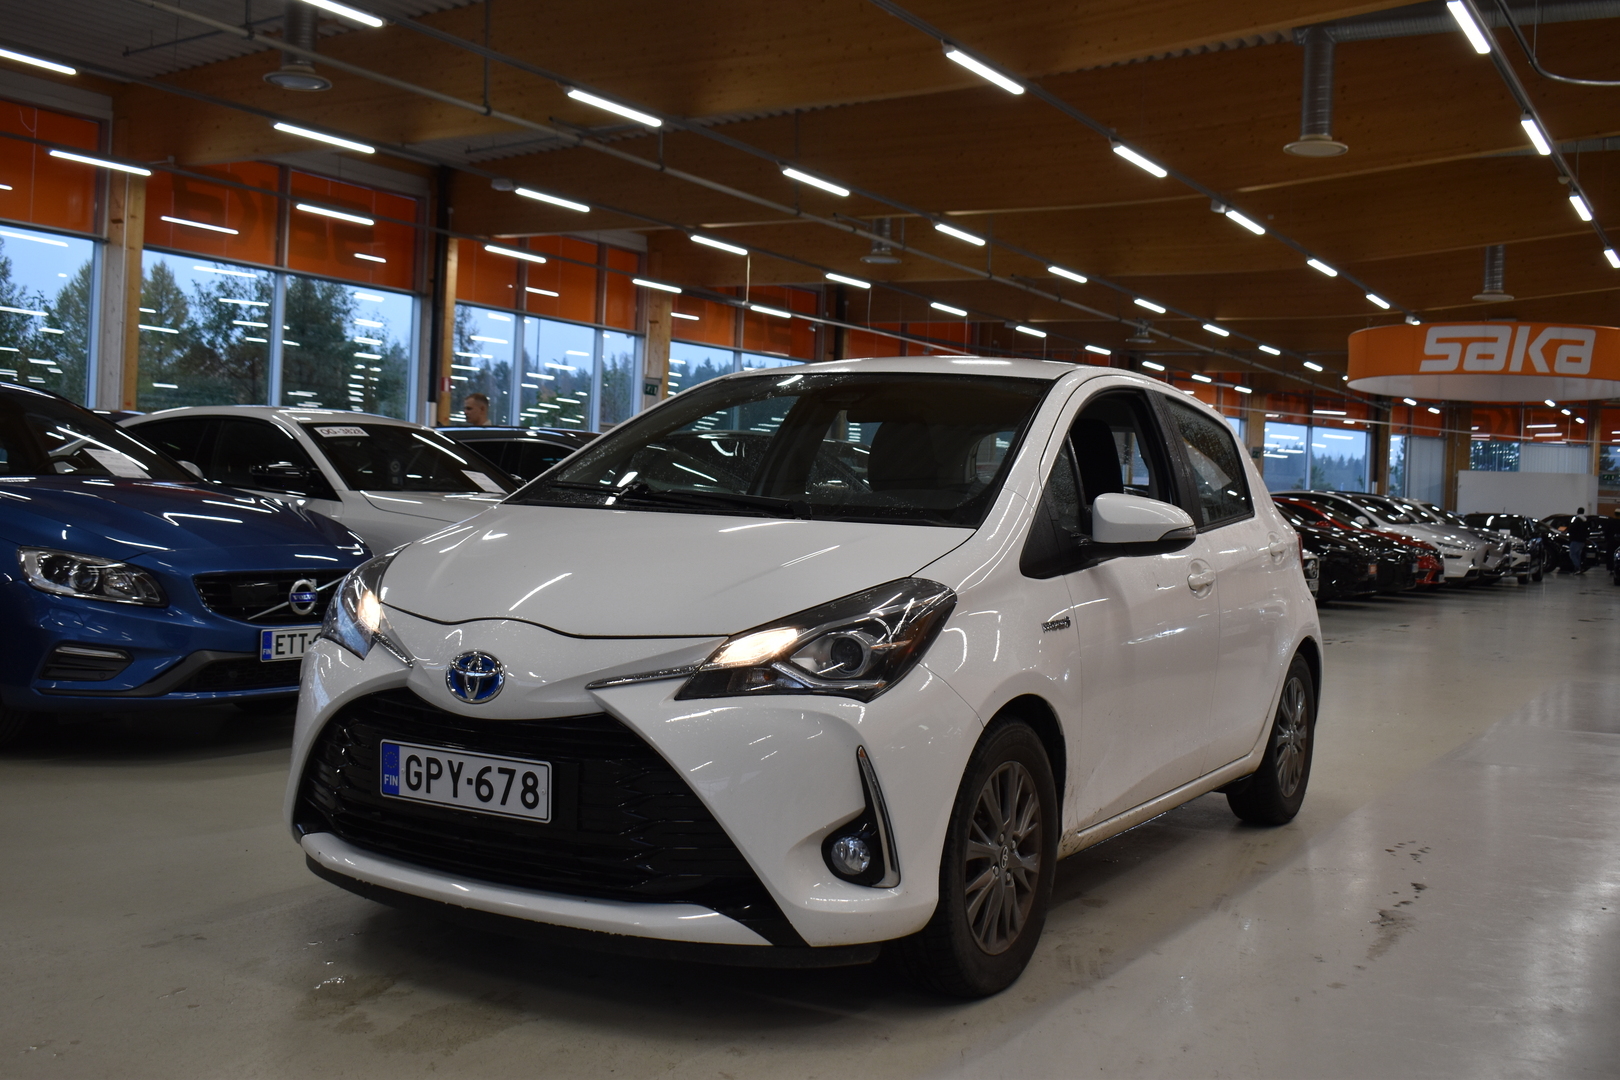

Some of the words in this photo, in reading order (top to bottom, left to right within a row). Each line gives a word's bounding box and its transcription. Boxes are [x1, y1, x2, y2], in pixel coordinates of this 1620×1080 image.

[275, 633, 321, 655] ETT-
[384, 774, 399, 787] FIN
[405, 754, 540, 810] GPY-678
